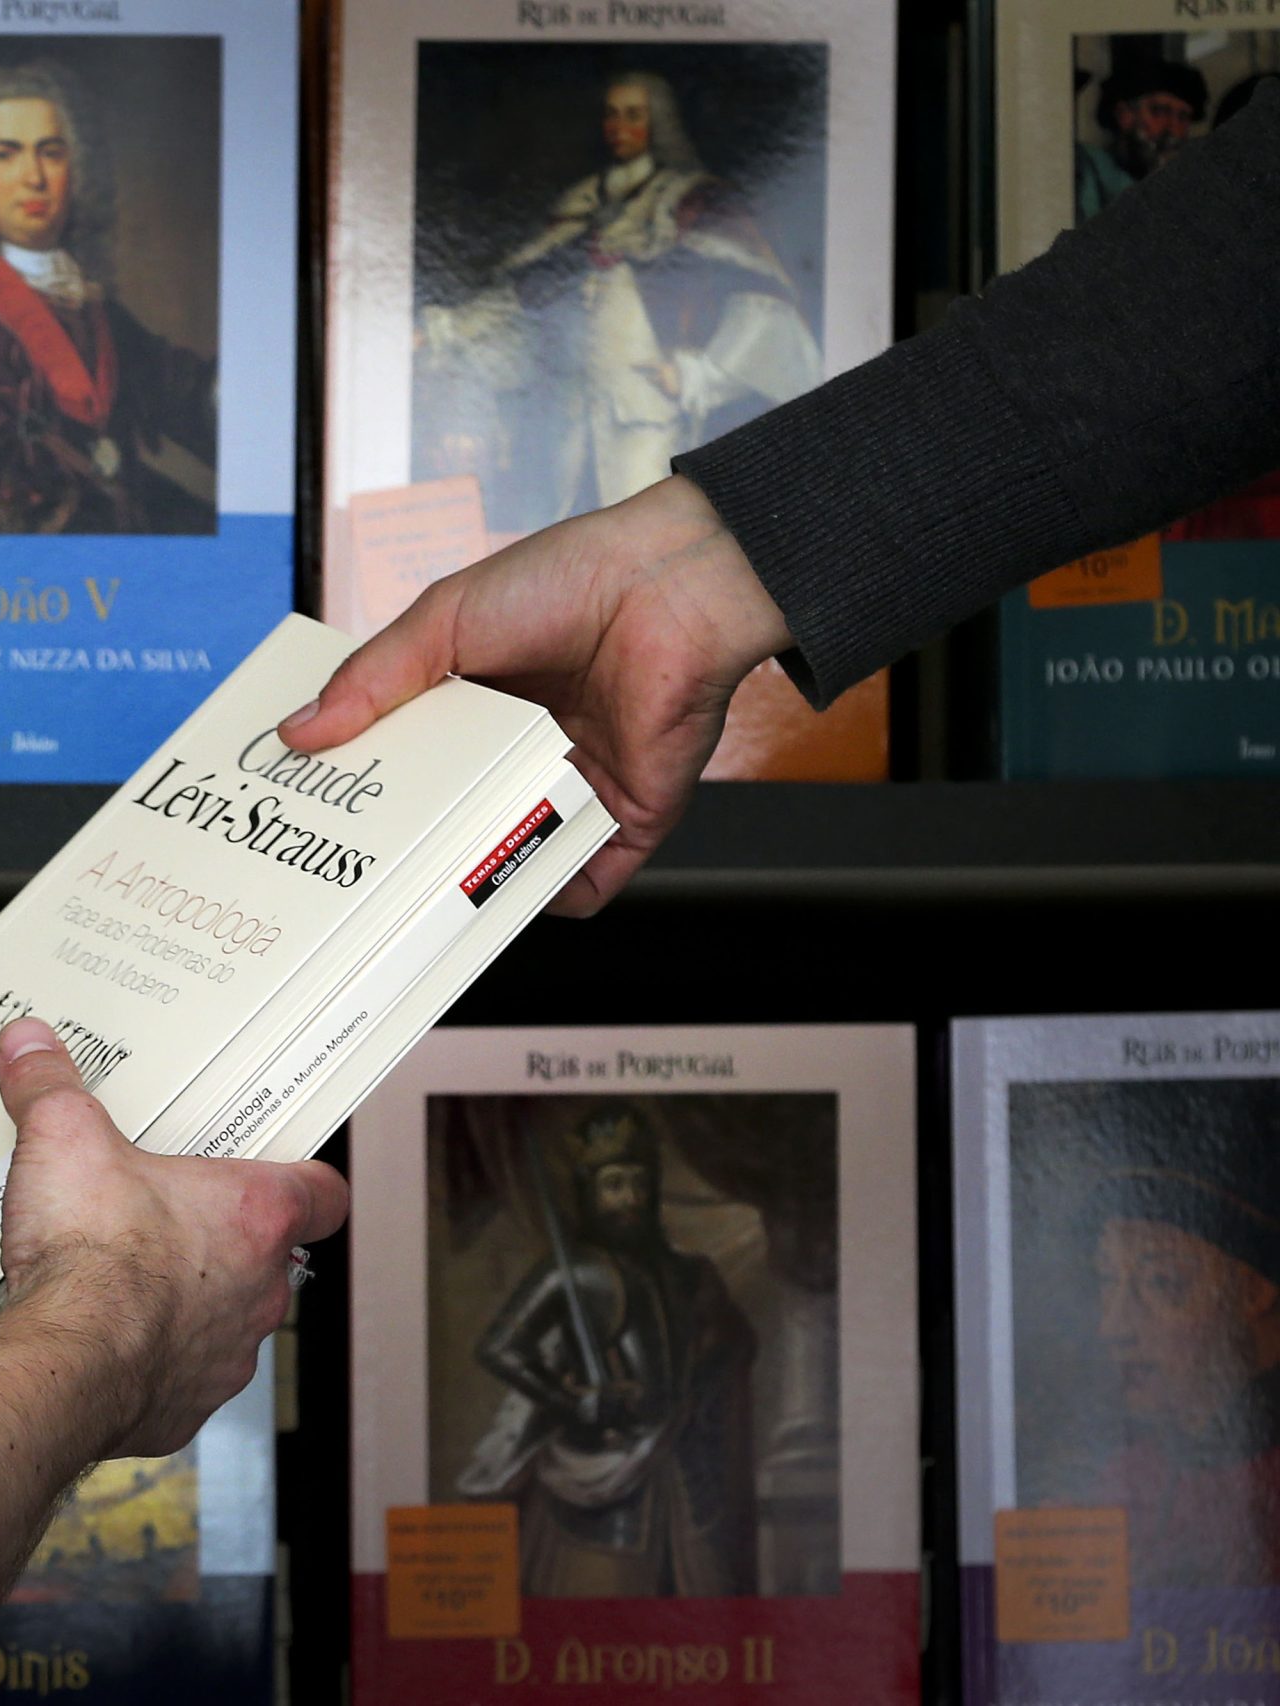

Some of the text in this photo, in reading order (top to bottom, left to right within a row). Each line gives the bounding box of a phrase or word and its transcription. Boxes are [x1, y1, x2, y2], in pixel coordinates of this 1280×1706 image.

[85, 577, 121, 622] V
[1153, 599, 1198, 647] D.
[10, 648, 91, 671] NIZZA
[96, 648, 136, 671] DA
[140, 648, 212, 672] SILVA
[1045, 653, 1125, 687] JOÃO
[1137, 655, 1236, 683] PAULO
[238, 727, 384, 814] Claude
[132, 758, 377, 888] Lévi-Strauss
[464, 858, 497, 889] TEMAS
[505, 805, 549, 849] DEBATES
[57, 896, 236, 984] Face aos Problemas do
[77, 850, 282, 957] A Antropologia
[52, 937, 180, 1005] Mundo Moderno
[232, 1097, 283, 1148] Problemas
[281, 1084, 296, 1100] do
[293, 1051, 328, 1087] Mundo
[325, 1009, 369, 1054] Moderno
[494, 1636, 540, 1686] D.
[742, 1636, 775, 1685] II
